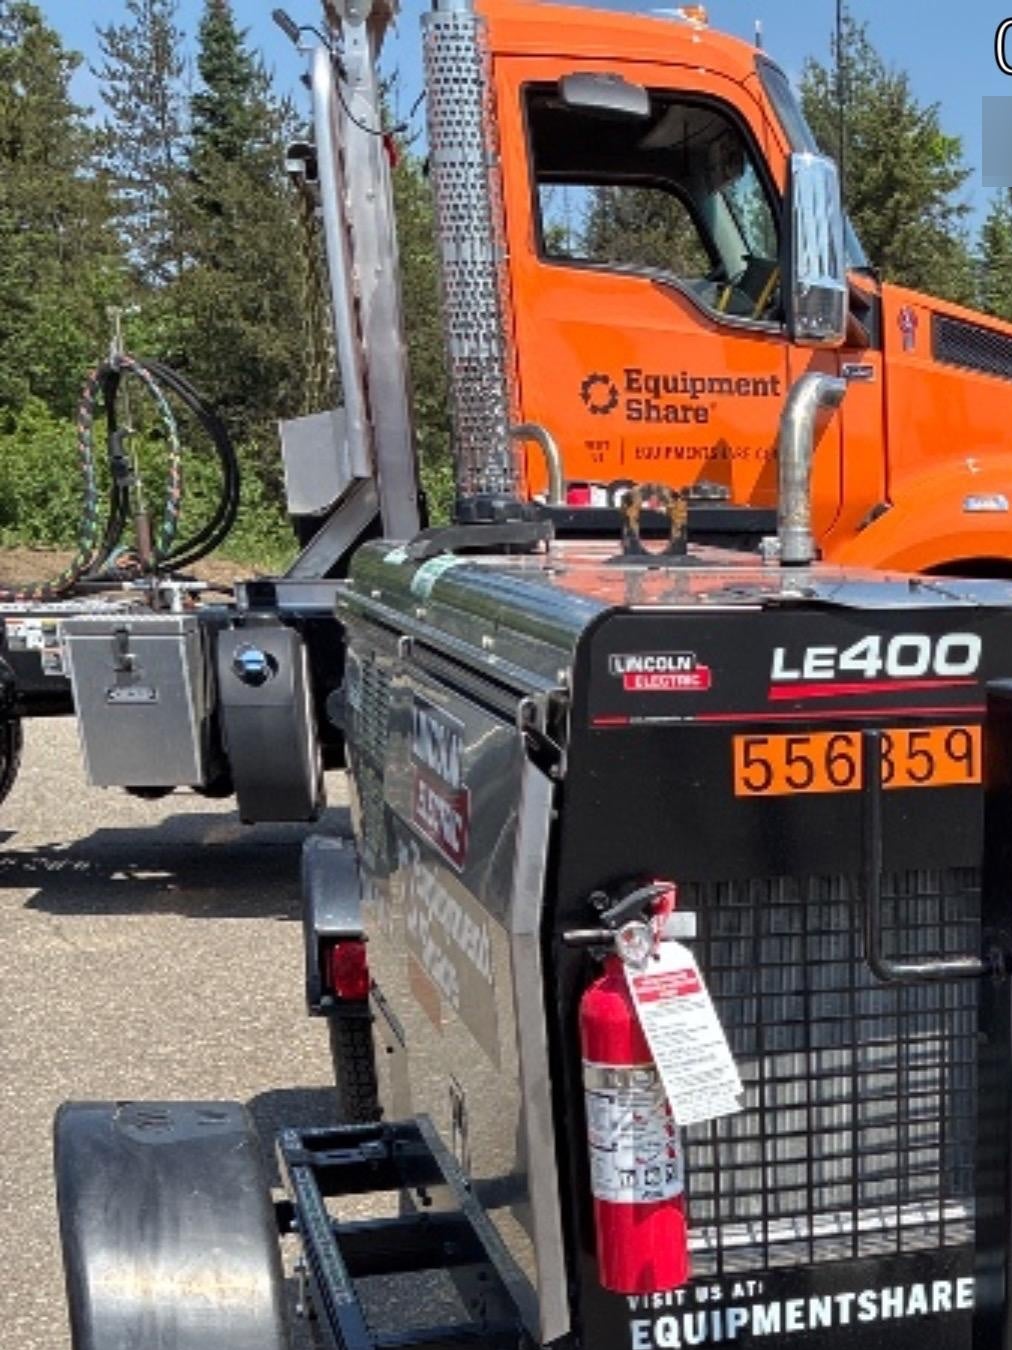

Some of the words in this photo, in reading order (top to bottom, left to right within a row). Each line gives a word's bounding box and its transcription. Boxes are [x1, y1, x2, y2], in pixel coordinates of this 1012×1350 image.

[623, 368, 781, 399] Equipment
[626, 398, 710, 424] Share
[614, 655, 692, 673] LINCOLN
[770, 632, 983, 680] LE400
[634, 673, 702, 689] ELECTRIC
[626, 1289, 687, 1312] VISIT
[695, 1285, 723, 1303] US
